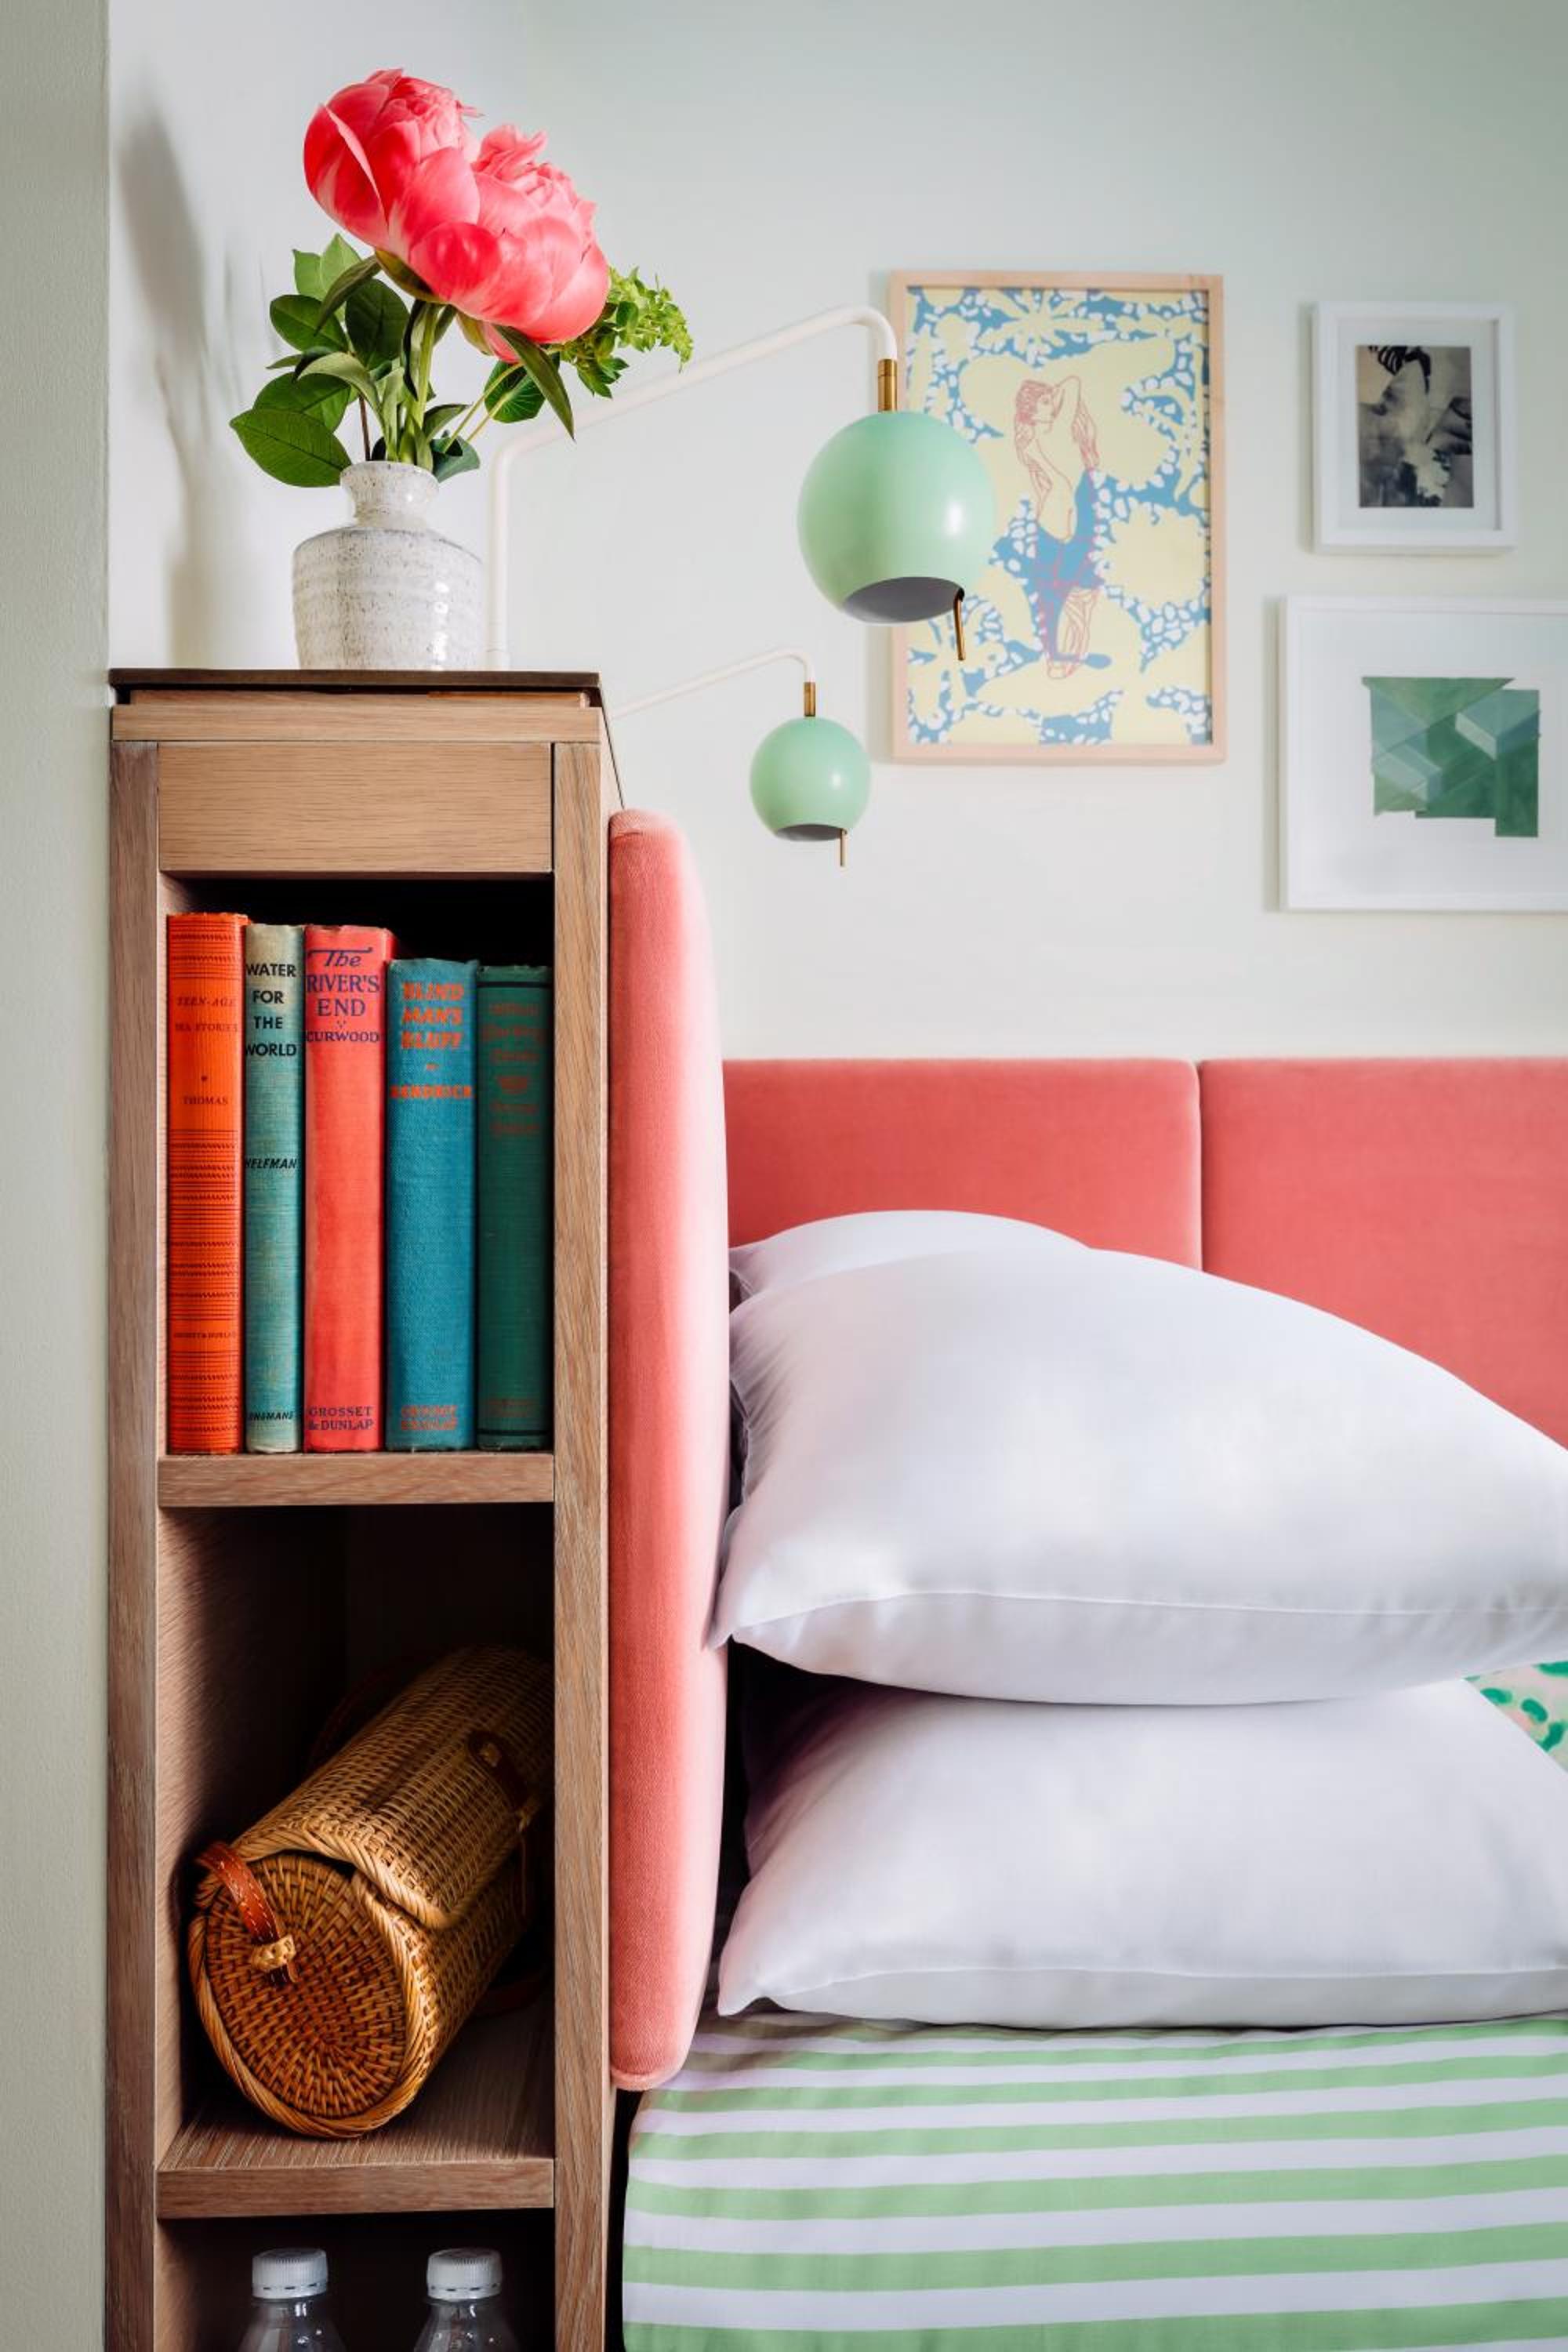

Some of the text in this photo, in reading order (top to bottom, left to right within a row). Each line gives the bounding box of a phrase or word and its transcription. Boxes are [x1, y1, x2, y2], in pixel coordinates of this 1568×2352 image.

[307, 947, 372, 967] The
[245, 964, 296, 978] WATER
[307, 975, 379, 993] RIVER'S
[252, 990, 285, 1004] FOR
[318, 998, 366, 1017] END
[253, 1015, 284, 1029] THE
[306, 1031, 379, 1042] CURWOOD
[245, 1044, 297, 1057] WORLD
[183, 1095, 229, 1105] THOMAS
[309, 1406, 373, 1417] GROSSET
[321, 1419, 374, 1431] DUNLAP
